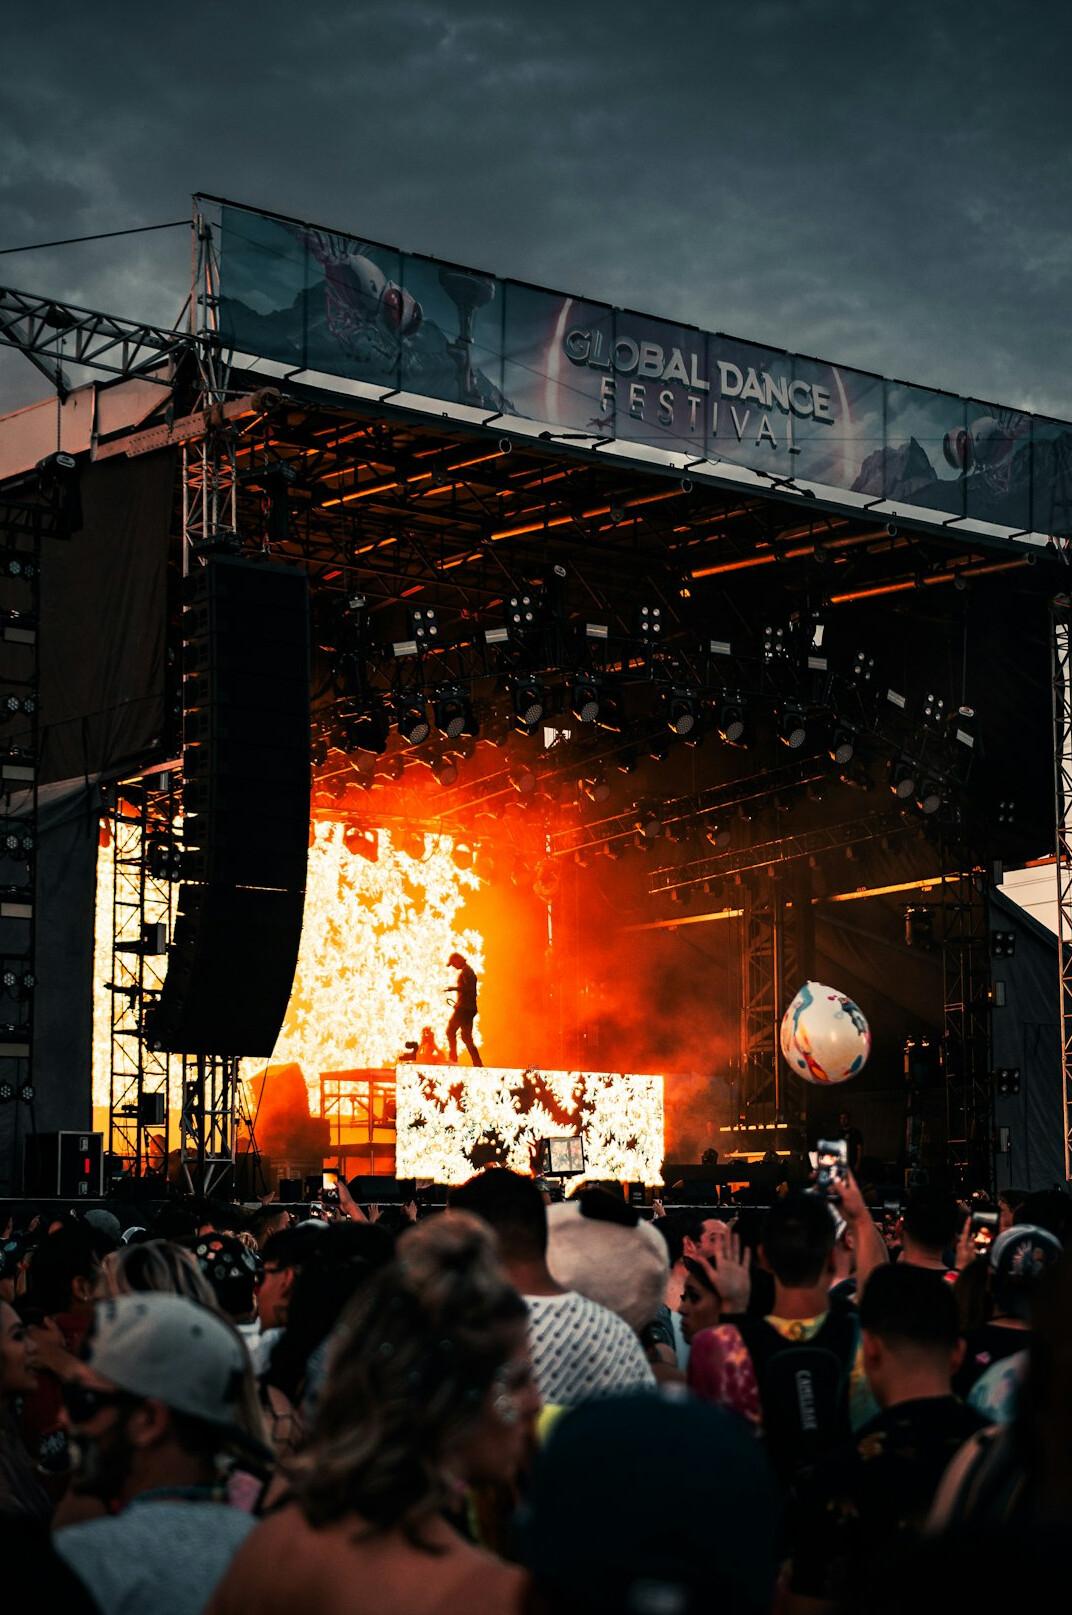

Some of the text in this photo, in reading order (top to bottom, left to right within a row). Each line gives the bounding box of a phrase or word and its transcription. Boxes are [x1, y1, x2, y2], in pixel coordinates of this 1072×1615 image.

[563, 326, 834, 424] GLOBAL DANCE
[600, 376, 801, 454] FESTIVAL
